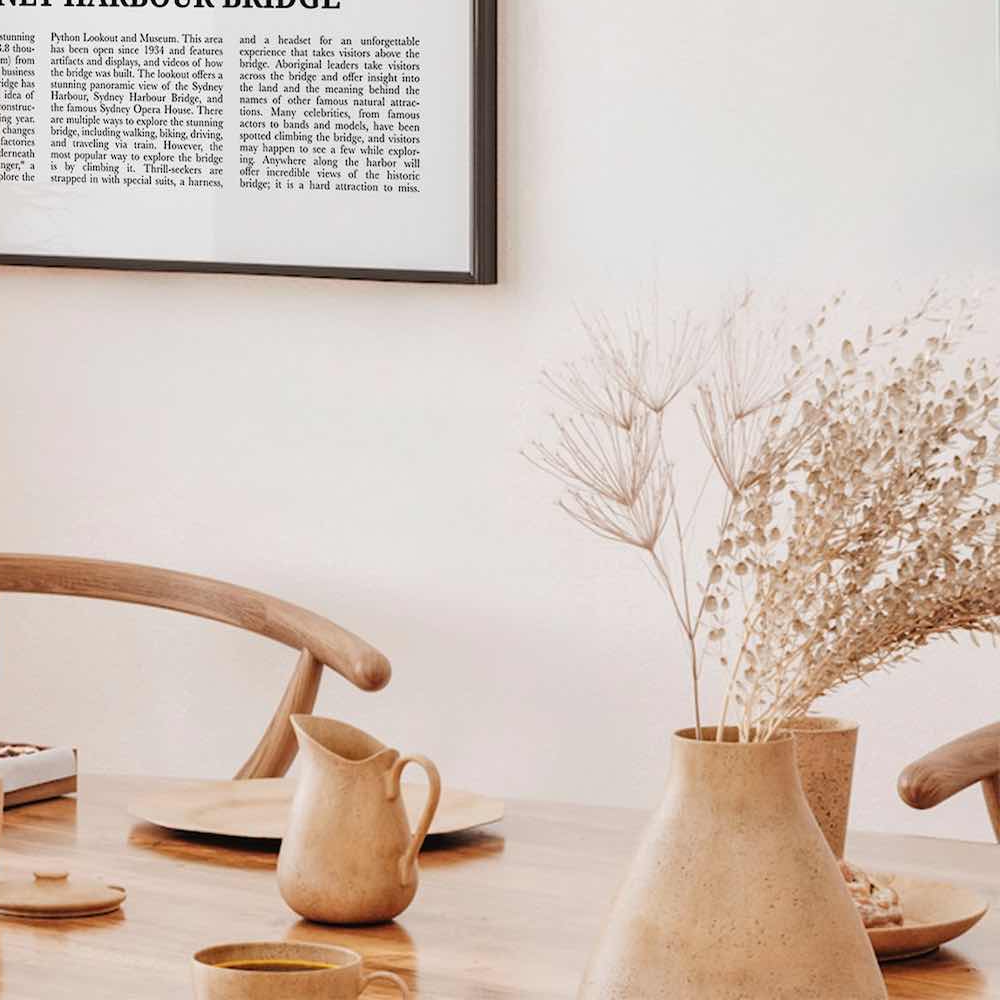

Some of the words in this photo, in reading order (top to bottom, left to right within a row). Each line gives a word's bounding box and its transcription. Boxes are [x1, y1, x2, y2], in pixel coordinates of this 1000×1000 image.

[50, 32, 80, 44] Python
[83, 33, 118, 42] Lookout
[120, 33, 137, 42] and
[139, 33, 179, 43] Museum.
[182, 34, 202, 43] This
[240, 35, 256, 44] and
[277, 35, 311, 45] headset
[319, 36, 332, 45] for
[360, 36, 420, 48] unforgettable
[12, 43, 35, 52] thou-
[14, 55, 35, 64] from
[50, 56, 84, 66] artifacts
[86, 56, 102, 66] and
[104, 57, 140, 68] displays,
[143, 57, 160, 66] and
[162, 57, 189, 67] videos
[191, 58, 200, 67] of
[204, 58, 223, 67] how
[239, 59, 269, 71] bridge.
[274, 59, 322, 71] Aboriginal
[327, 60, 359, 69] leaders
[363, 60, 383, 70] take
[387, 62, 420, 70] visitors
[20, 78, 35, 87] has
[50, 81, 87, 91] stunning
[89, 81, 135, 92] panoramic
[138, 82, 158, 90] view
[161, 81, 170, 90] of
[174, 81, 188, 90] the
[191, 81, 223, 93] Sydney
[239, 83, 253, 92] the
[258, 83, 278, 93] land
[283, 84, 300, 93] and
[305, 84, 319, 93] the
[324, 85, 363, 96] meaning
[368, 85, 400, 94] behind
[405, 85, 420, 94] the
[50, 103, 64, 113] the
[66, 103, 97, 113] famous
[99, 104, 130, 116] Sydney
[133, 104, 160, 116] Opera
[164, 105, 194, 114] House.
[197, 105, 223, 115] There
[240, 108, 263, 116] tions.
[270, 107, 296, 119] Many
[303, 108, 351, 119] celebrities,
[358, 109, 379, 118] from
[387, 109, 420, 119] famous
[1, 124, 35, 136] changes
[50, 127, 80, 138] bridge,
[81, 127, 121, 139] including
[122, 128, 157, 140] walking,
[159, 129, 188, 141] biking,
[189, 129, 223, 141] driving,
[239, 131, 271, 143] spotted
[273, 131, 313, 144] climbing
[315, 132, 330, 142] the
[333, 133, 364, 145] bridge,
[367, 133, 385, 143] and
[387, 135, 420, 144] visitors
[50, 151, 71, 159] most
[73, 150, 107, 162] popular
[110, 154, 127, 163] way
[130, 152, 140, 161] to
[142, 152, 174, 164] explore
[178, 152, 192, 162] the
[195, 153, 223, 165] bridge
[261, 155, 306, 167] Anywhere
[312, 156, 338, 168] along
[344, 157, 359, 166] the
[365, 158, 396, 167] harbor
[403, 158, 420, 168] will
[21, 172, 35, 181] the
[50, 173, 86, 186] strapped
[89, 175, 98, 184] in
[101, 175, 120, 184] with
[123, 175, 152, 187] special
[154, 177, 176, 187] suits,
[188, 177, 223, 188] harness,
[239, 178, 270, 191] bridge;
[275, 180, 282, 189] it
[286, 181, 294, 189] is
[308, 180, 330, 190] hard
[335, 182, 378, 191] attraction
[383, 183, 393, 192] to
[397, 184, 420, 192] miss.
